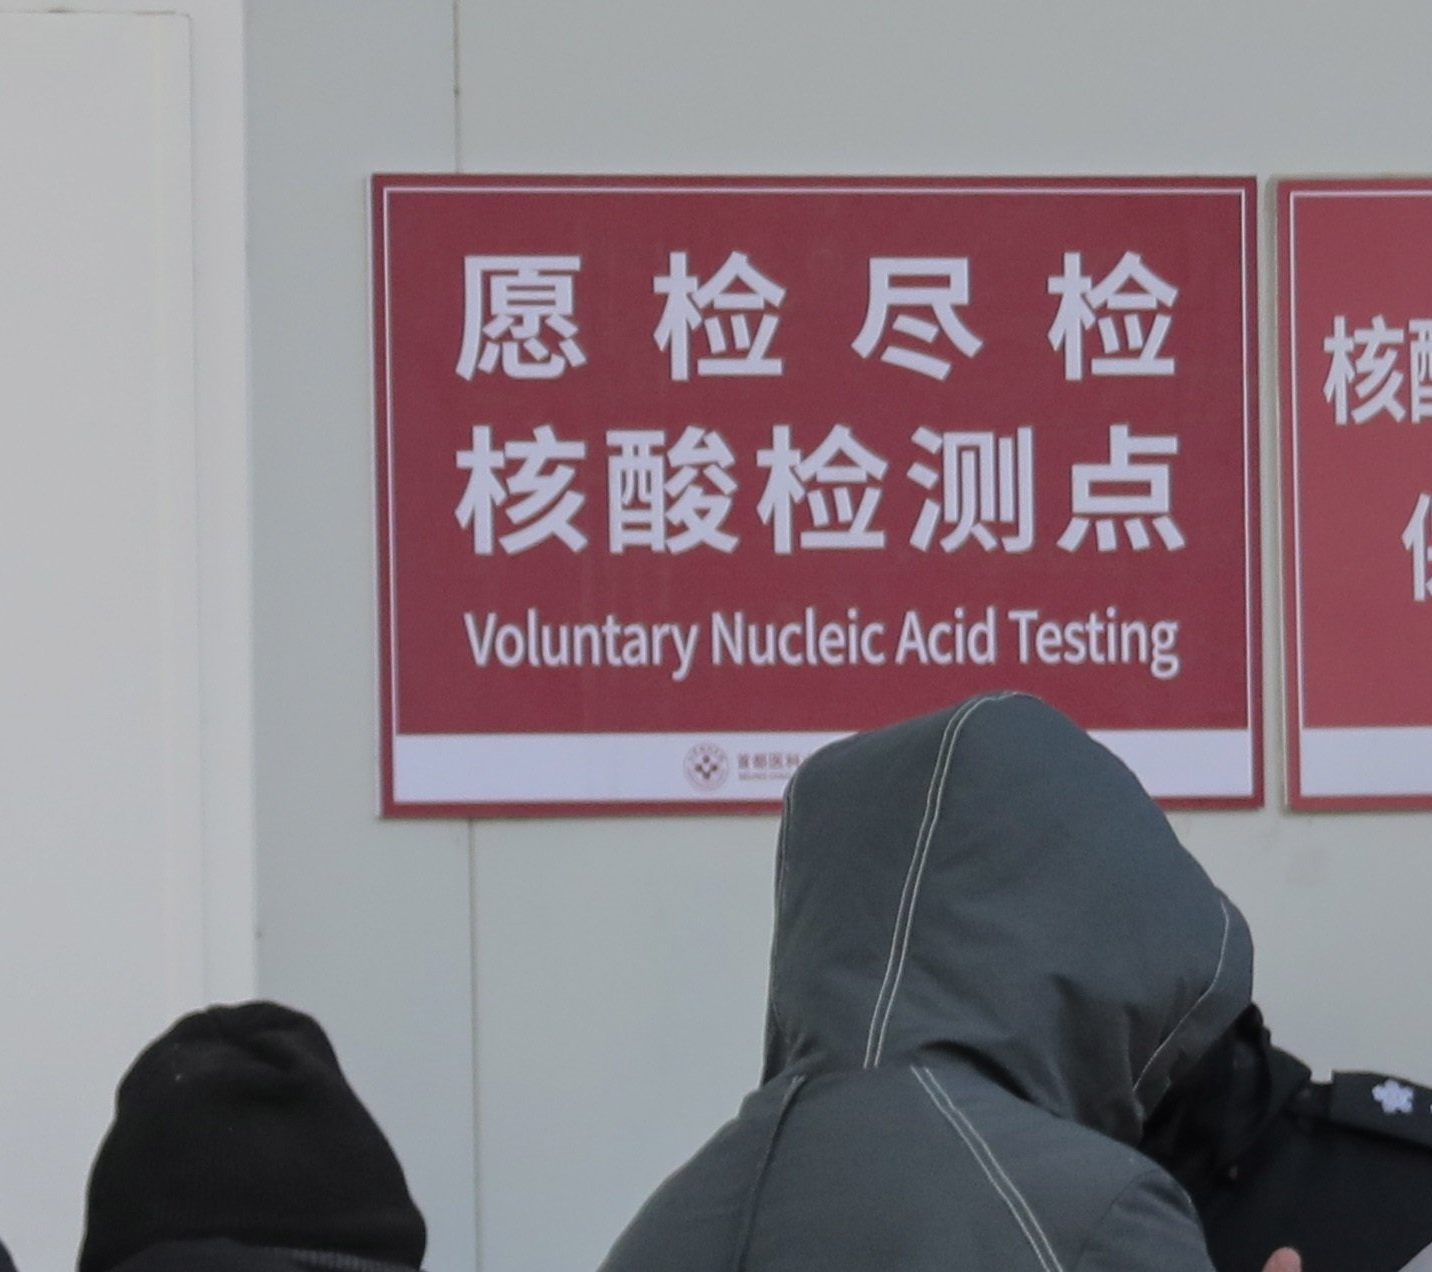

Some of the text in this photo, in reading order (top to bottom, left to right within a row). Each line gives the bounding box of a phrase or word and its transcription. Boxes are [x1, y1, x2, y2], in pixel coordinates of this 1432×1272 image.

[455, 251, 1179, 381] 愿检尽检
[455, 424, 1185, 555] 核酸检测点
[464, 606, 1180, 681] Voluntary Nucleic Acid Testing
